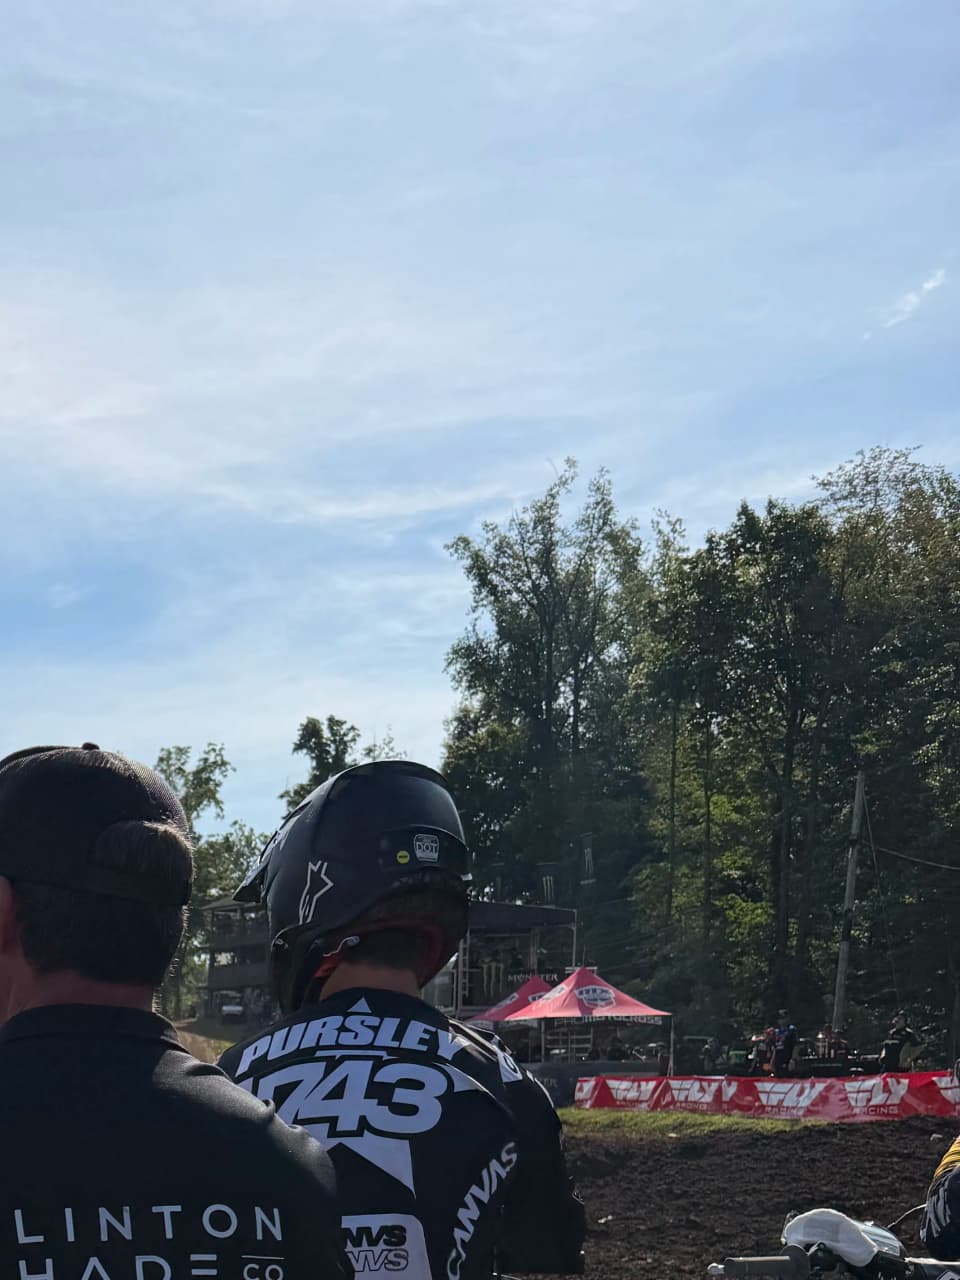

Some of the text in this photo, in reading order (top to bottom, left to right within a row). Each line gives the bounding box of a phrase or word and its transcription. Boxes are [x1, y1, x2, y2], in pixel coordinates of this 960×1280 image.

[416, 842, 437, 854] DOT
[507, 973, 558, 982] MONTER
[235, 1015, 465, 1077] PURSLEY
[256, 1060, 448, 1134] 743
[844, 1077, 909, 1107] FLY
